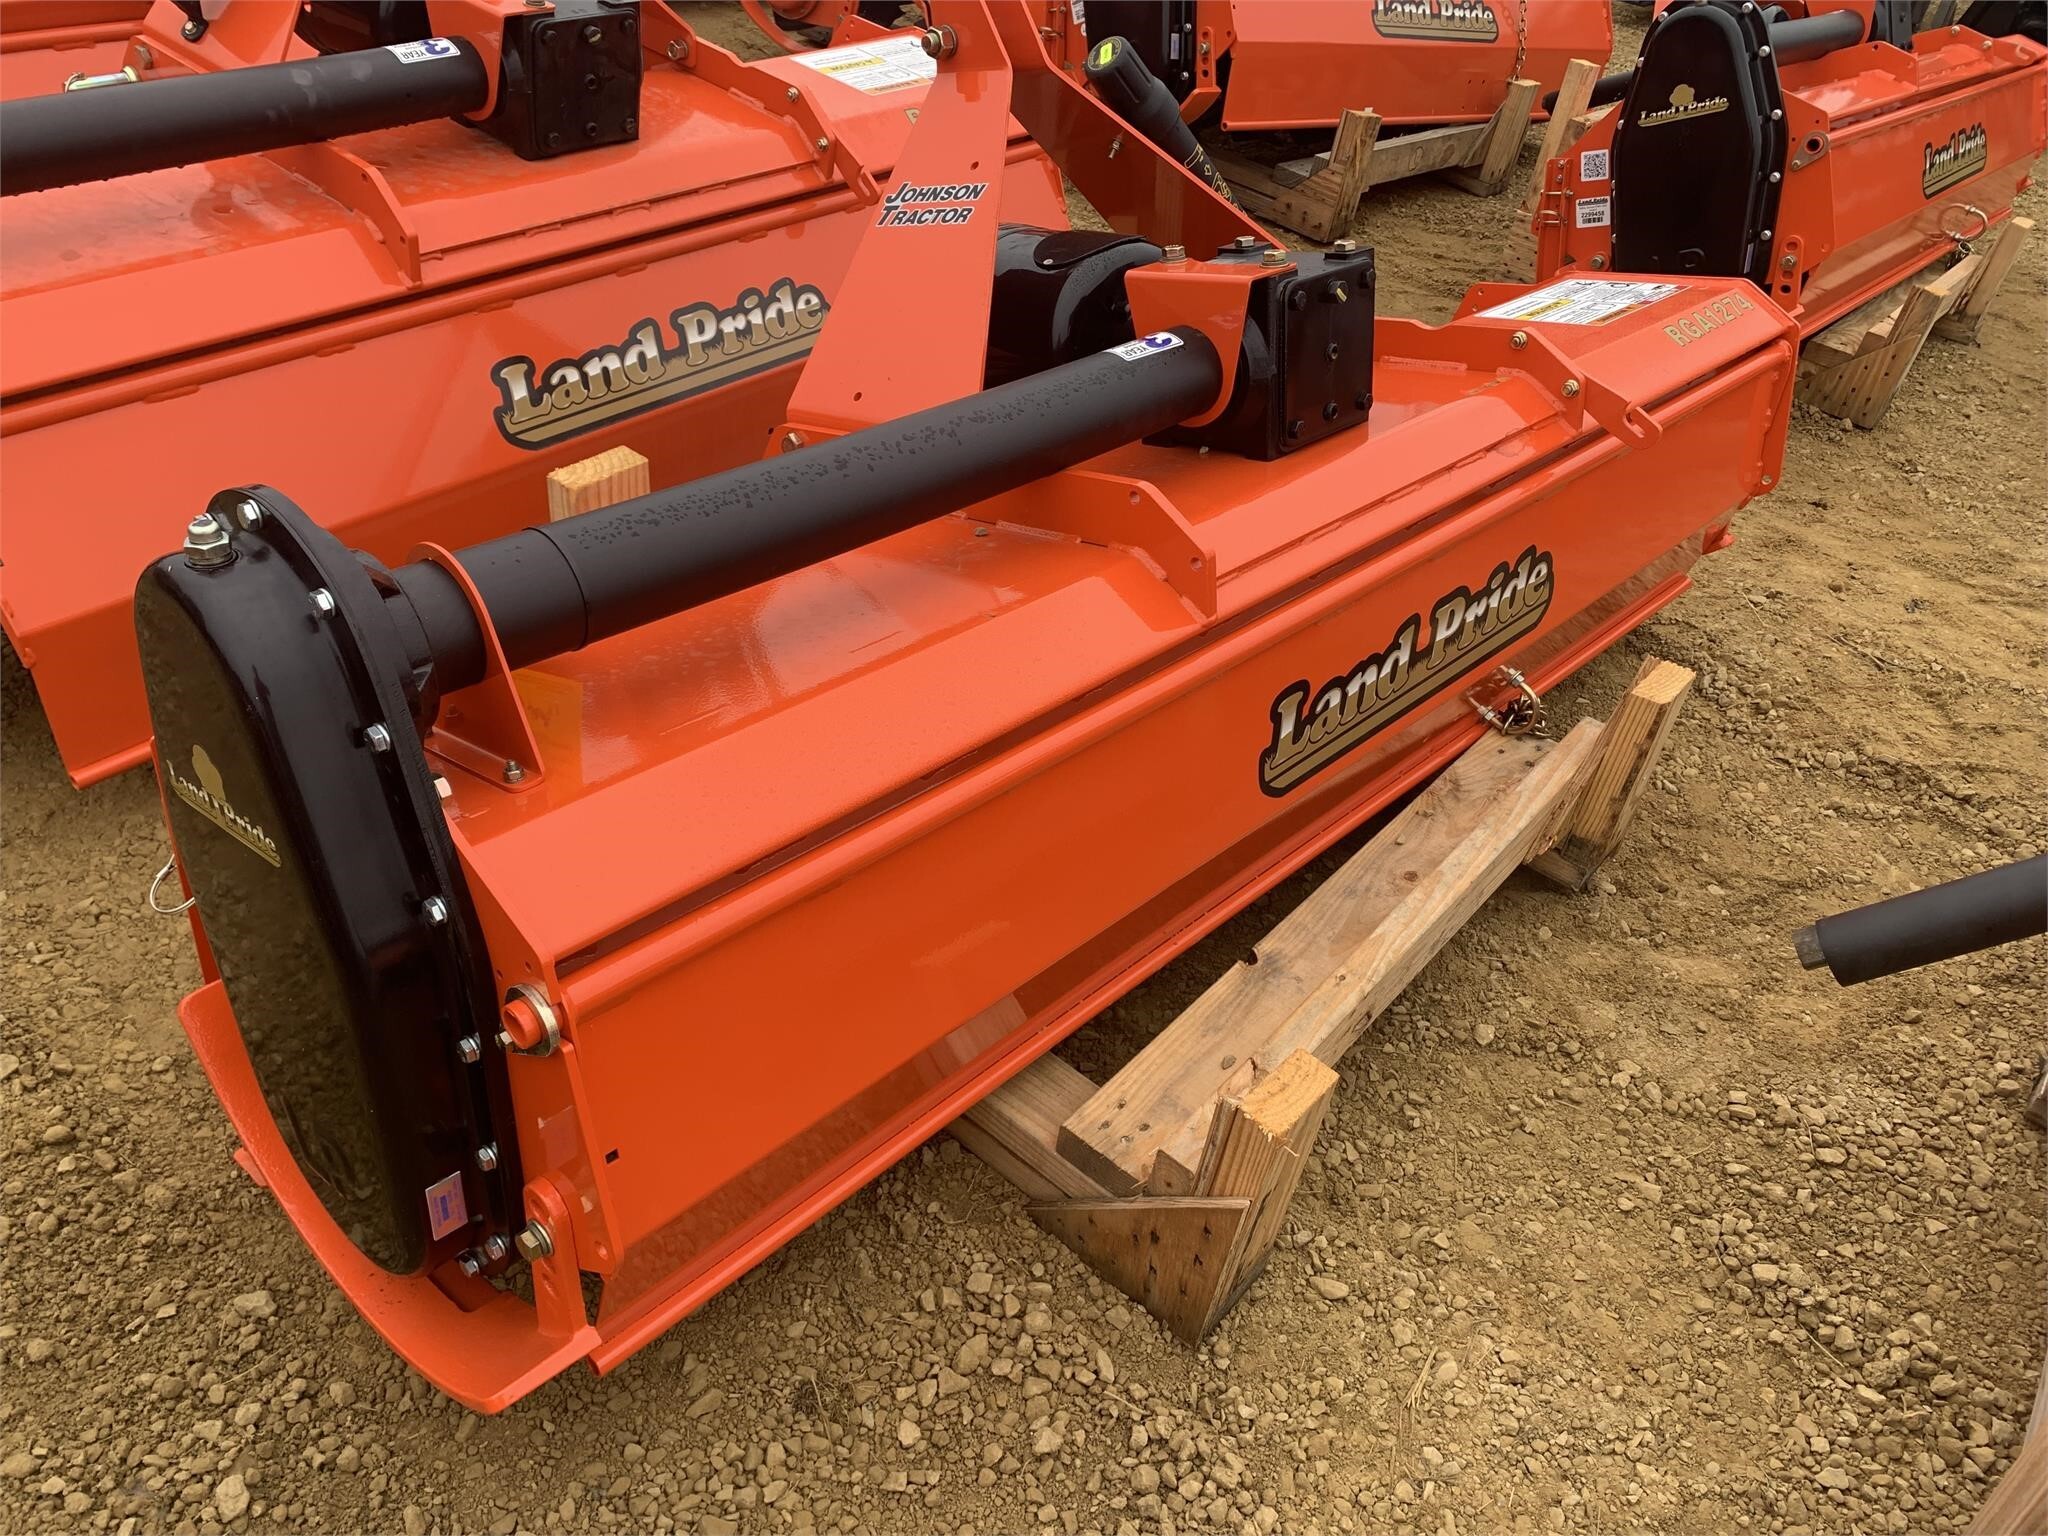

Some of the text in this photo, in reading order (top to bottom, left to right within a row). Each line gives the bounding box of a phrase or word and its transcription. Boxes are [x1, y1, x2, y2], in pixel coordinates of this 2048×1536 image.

[1376, 0, 1495, 31] Land Pride
[401, 49, 428, 60] YEAR
[1639, 96, 1729, 122] Land Pride
[1924, 127, 1986, 182] Land Pride
[885, 182, 987, 204] JOHNSON
[877, 204, 974, 226] TRACTOR
[1662, 292, 1755, 347] RGA1274
[499, 283, 825, 426] Land Pride
[1121, 345, 1149, 357] YEAR
[1269, 553, 1550, 771] Land Pride
[165, 759, 280, 862] Land Pride
